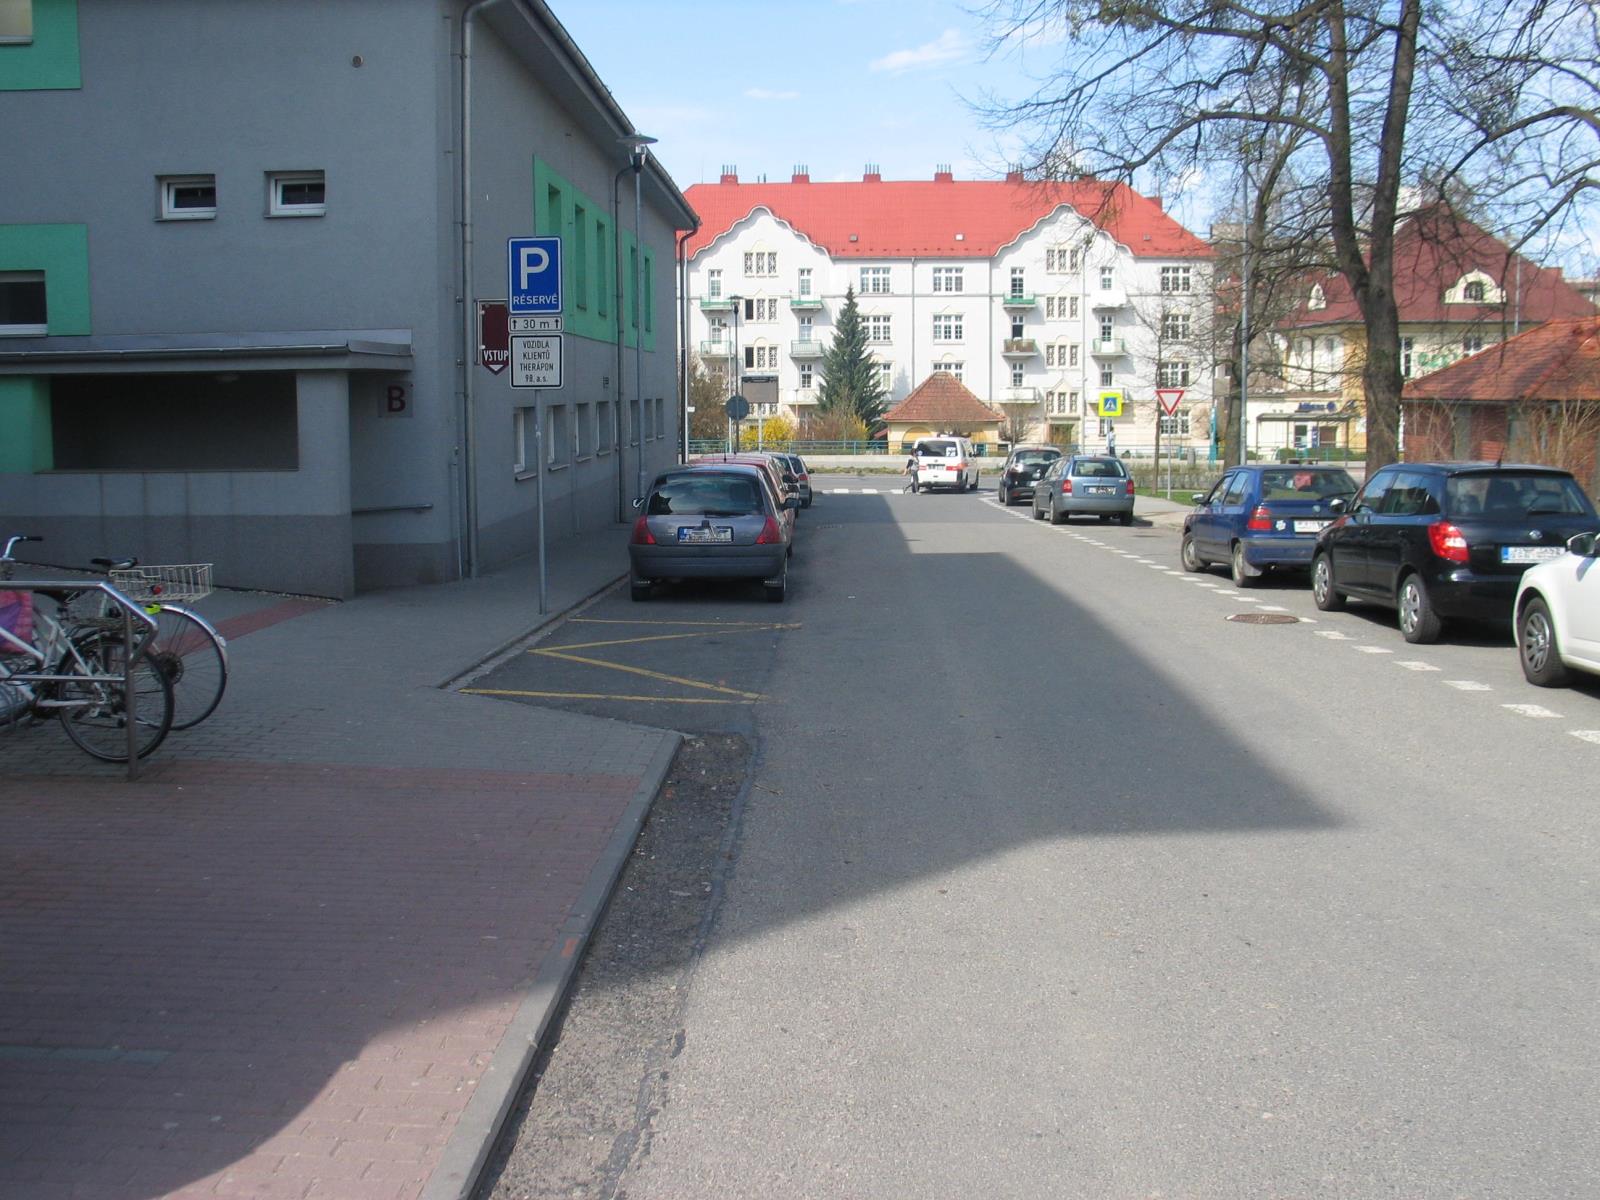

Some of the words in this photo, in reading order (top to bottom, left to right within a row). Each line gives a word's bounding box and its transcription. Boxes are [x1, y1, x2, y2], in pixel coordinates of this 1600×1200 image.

[520, 247, 550, 290] P
[513, 293, 558, 305] RÉSERVÉ
[523, 319, 536, 329] 30
[539, 321, 550, 329] m
[522, 340, 550, 349] VOZIDLA
[483, 349, 509, 361] VSTUP
[522, 349, 551, 360] KLIENTŮ
[519, 362, 554, 372] THERÁPON
[387, 385, 406, 412] B
